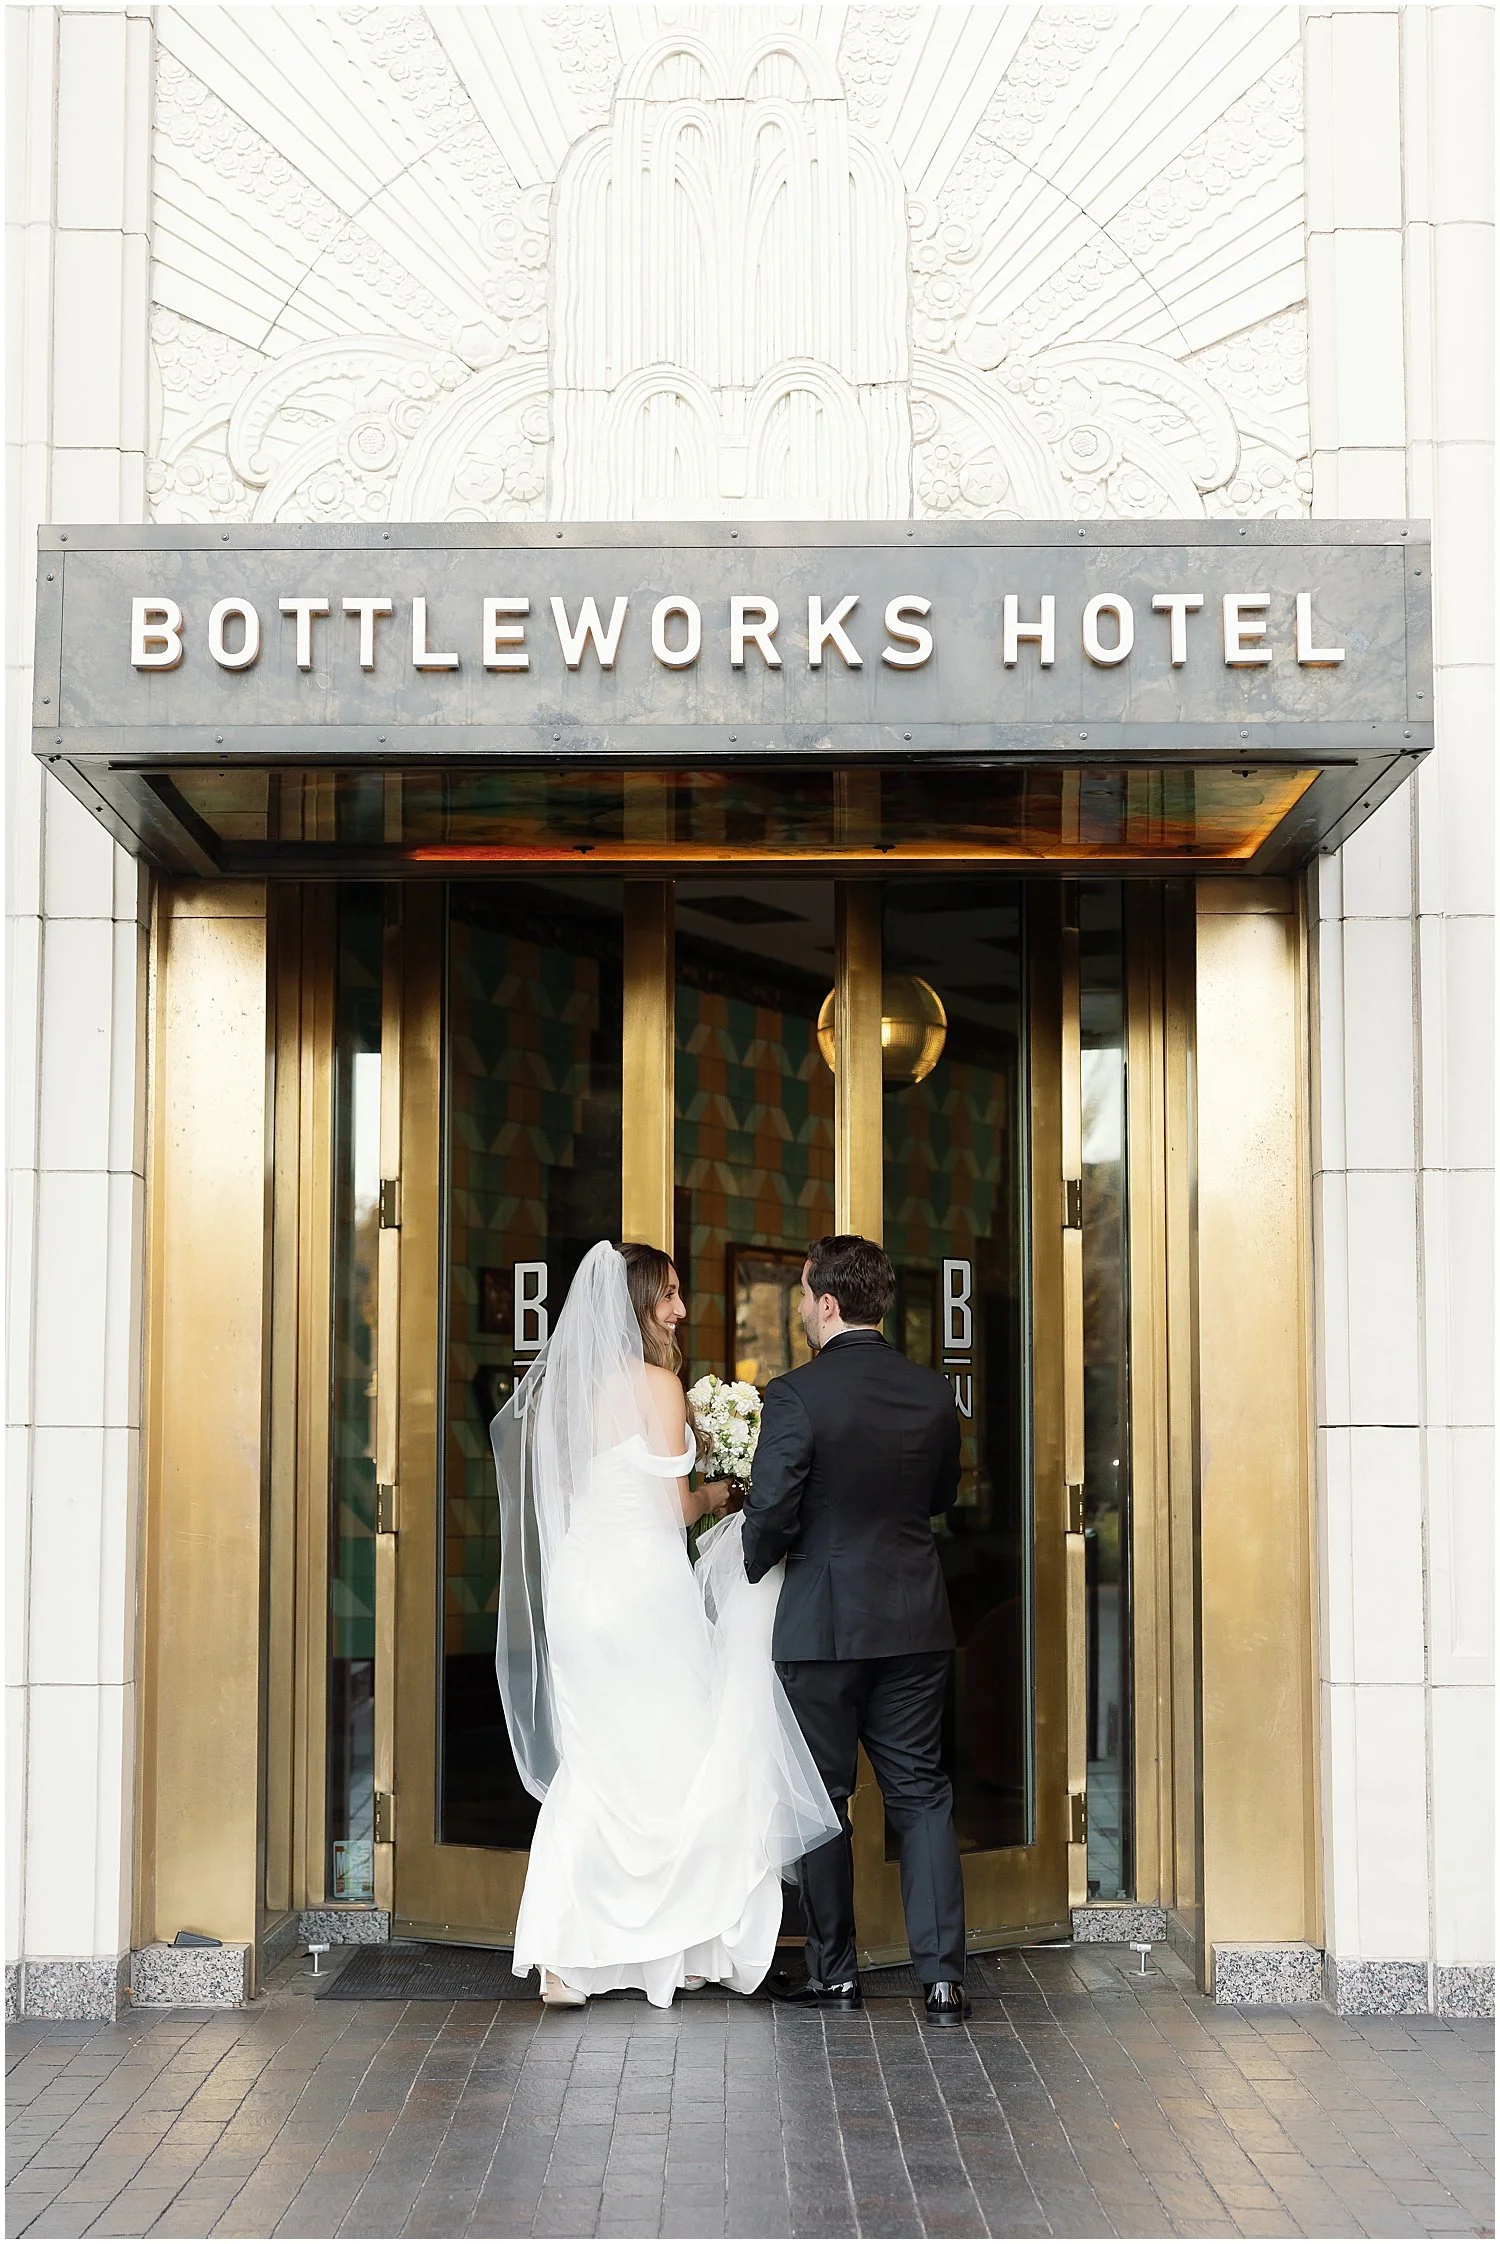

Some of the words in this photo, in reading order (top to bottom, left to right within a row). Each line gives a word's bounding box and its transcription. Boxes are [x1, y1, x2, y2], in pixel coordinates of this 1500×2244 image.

[130, 595, 935, 671] BOTTLEWORKS
[1002, 592, 1346, 668] HOTEL
[514, 1262, 548, 1350] B
[943, 1259, 972, 1348] B
